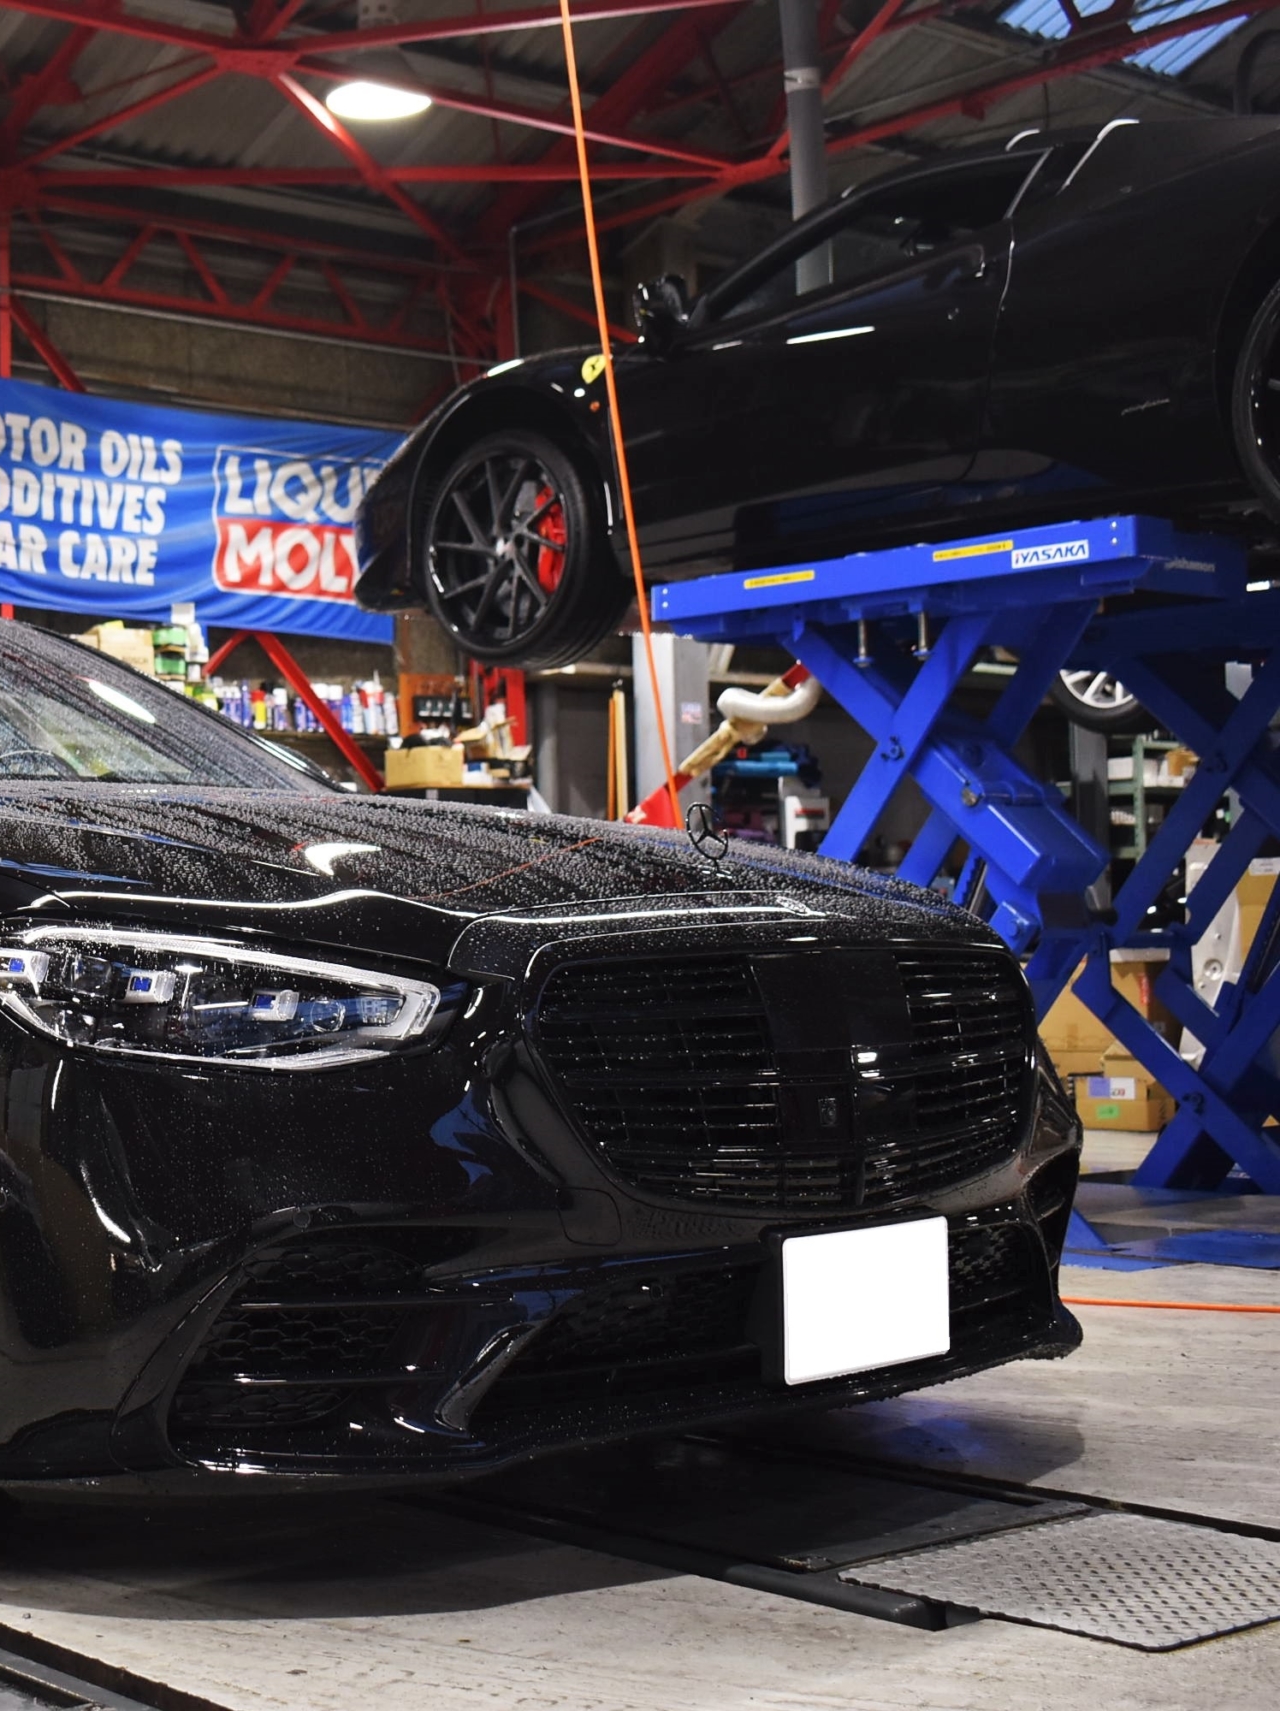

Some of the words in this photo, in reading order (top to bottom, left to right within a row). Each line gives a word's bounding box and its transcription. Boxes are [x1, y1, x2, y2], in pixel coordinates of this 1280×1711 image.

[100, 429, 183, 486] OILS
[224, 455, 382, 525] LIQU
[58, 530, 159, 587] CARE
